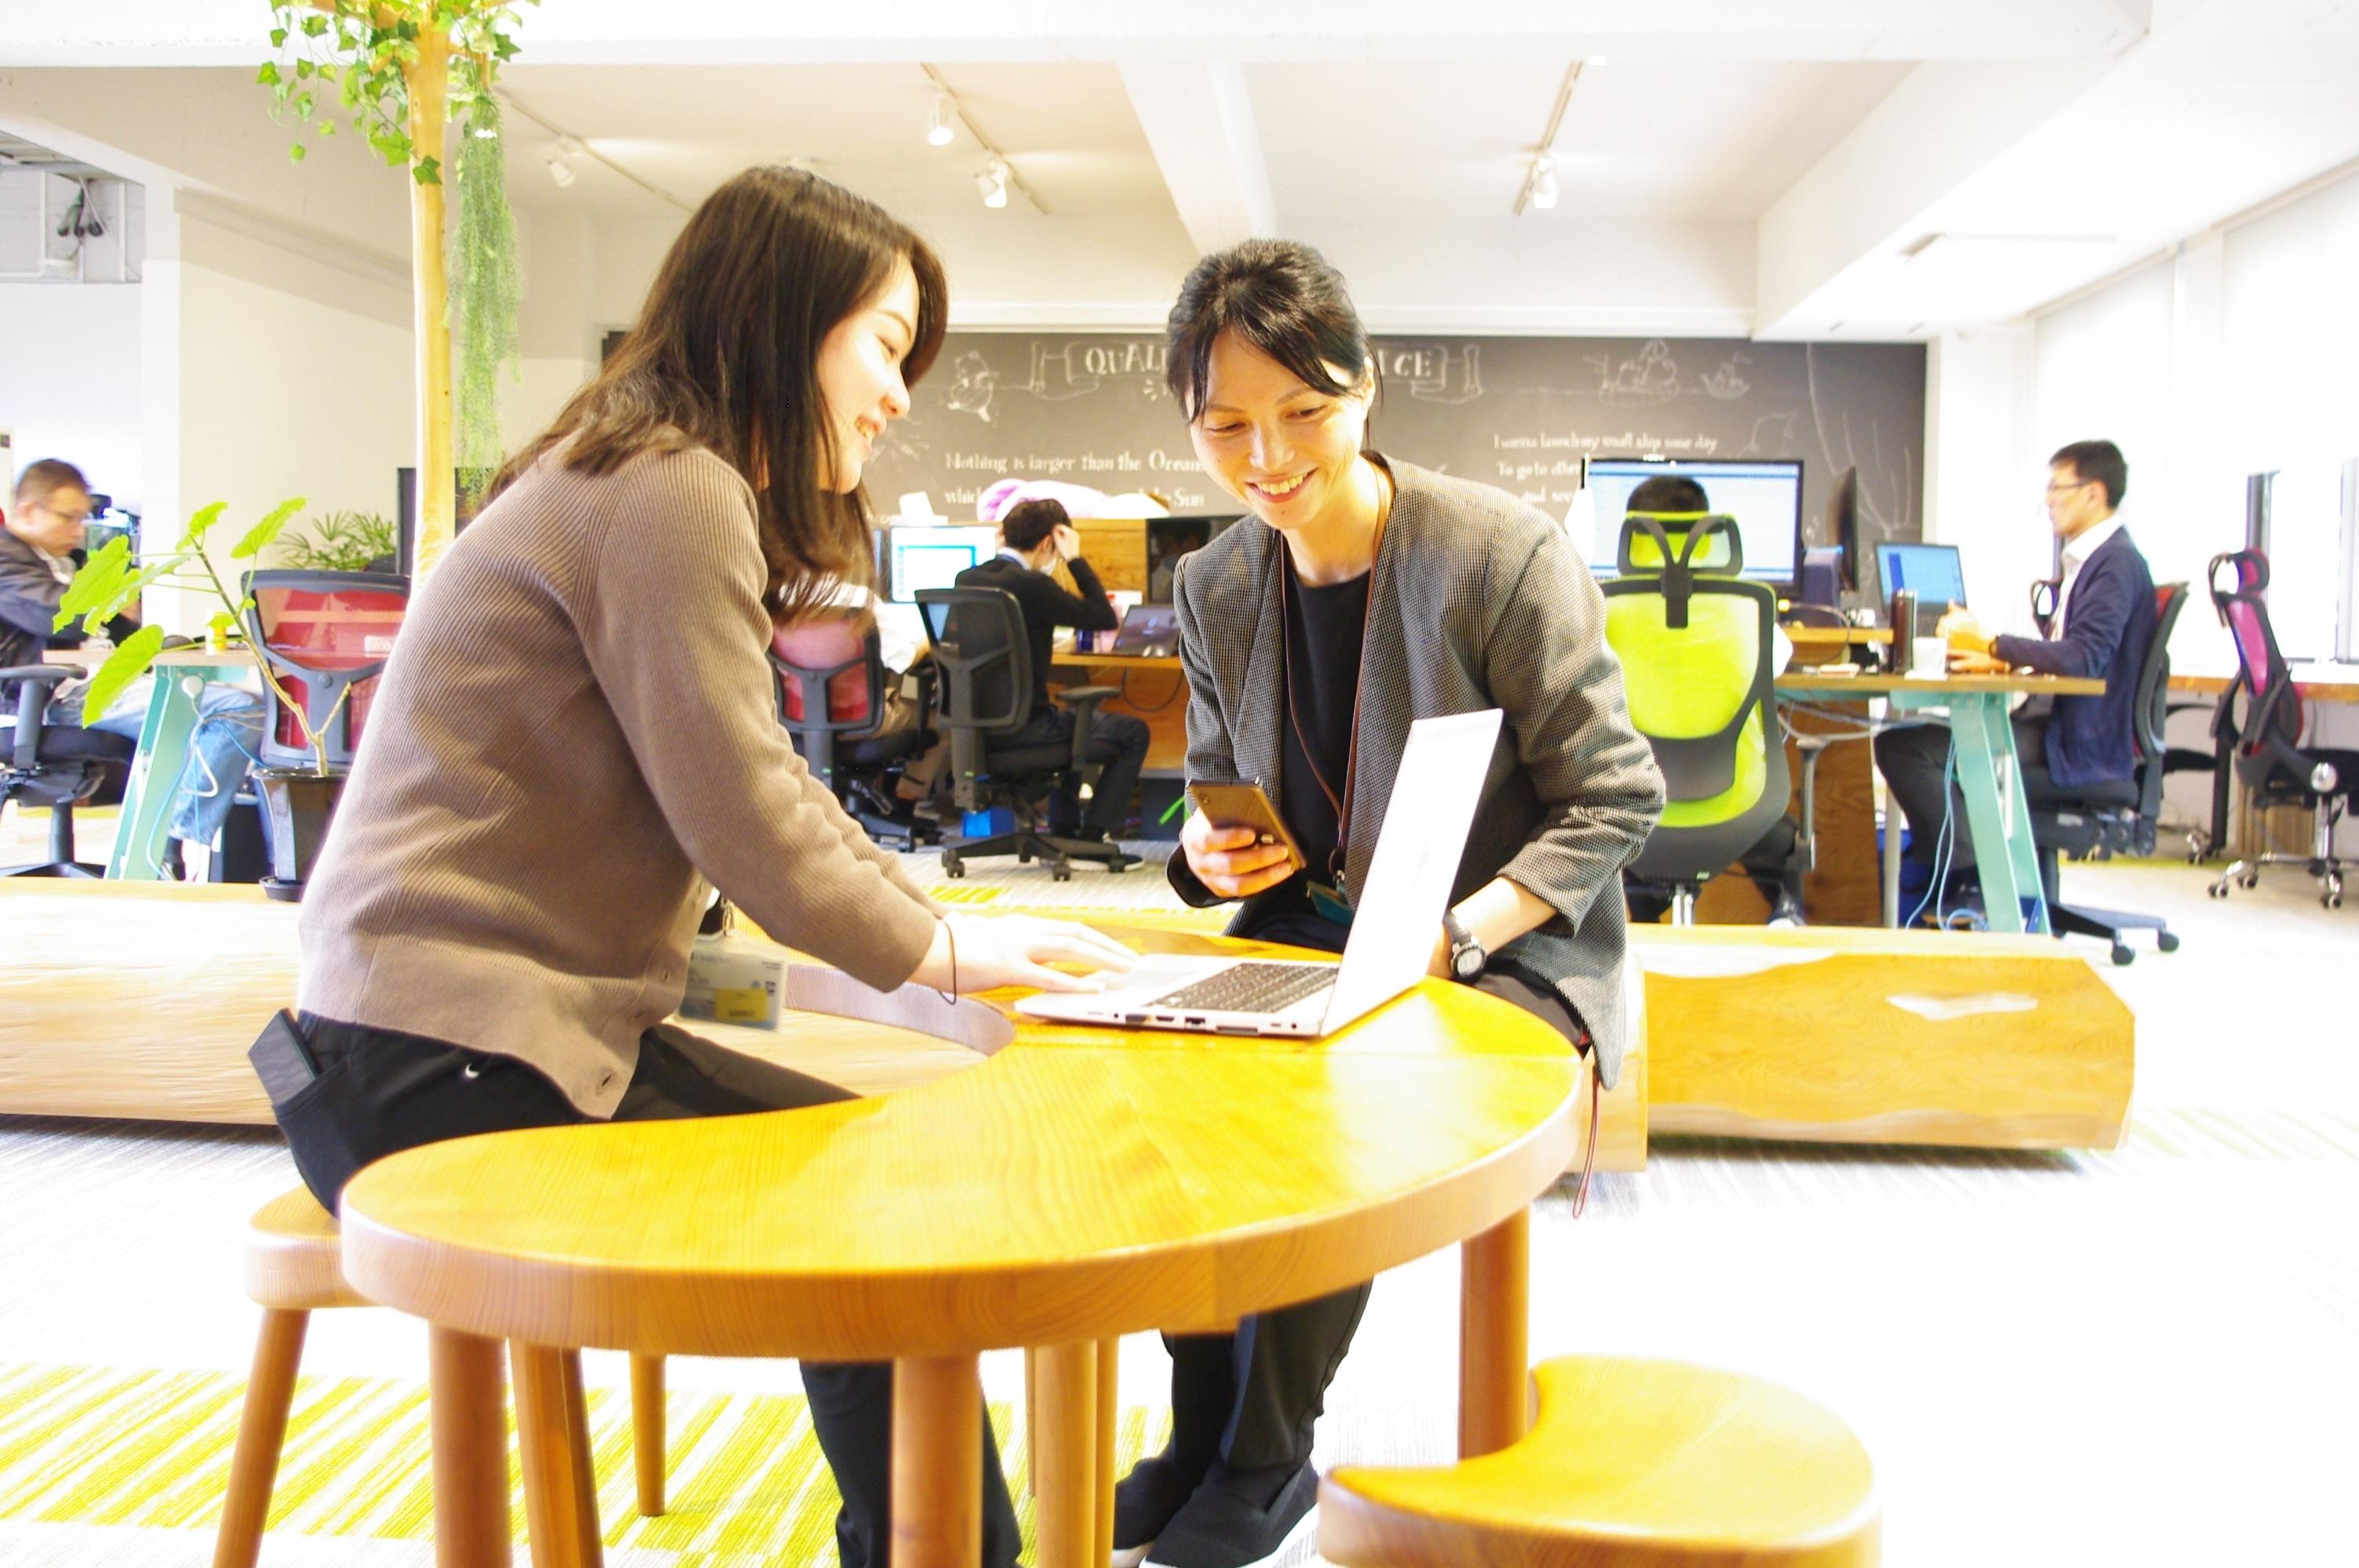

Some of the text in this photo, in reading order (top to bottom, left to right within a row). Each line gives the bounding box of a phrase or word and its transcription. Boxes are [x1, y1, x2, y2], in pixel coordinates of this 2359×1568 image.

[1494, 434, 1499, 448] I
[1501, 438, 1537, 448] wanna
[1601, 432, 1632, 448] small
[1635, 433, 1662, 452] ship
[1694, 434, 1718, 454] day
[945, 452, 1008, 474] Nothing
[1014, 457, 1025, 470] is
[1028, 455, 1076, 474] larger
[1081, 451, 1114, 471] than
[1118, 451, 1142, 470] the
[1496, 461, 1513, 476] To
[1517, 465, 1533, 481] go
[1534, 462, 1548, 477] to
[1173, 488, 1205, 507] Sun
